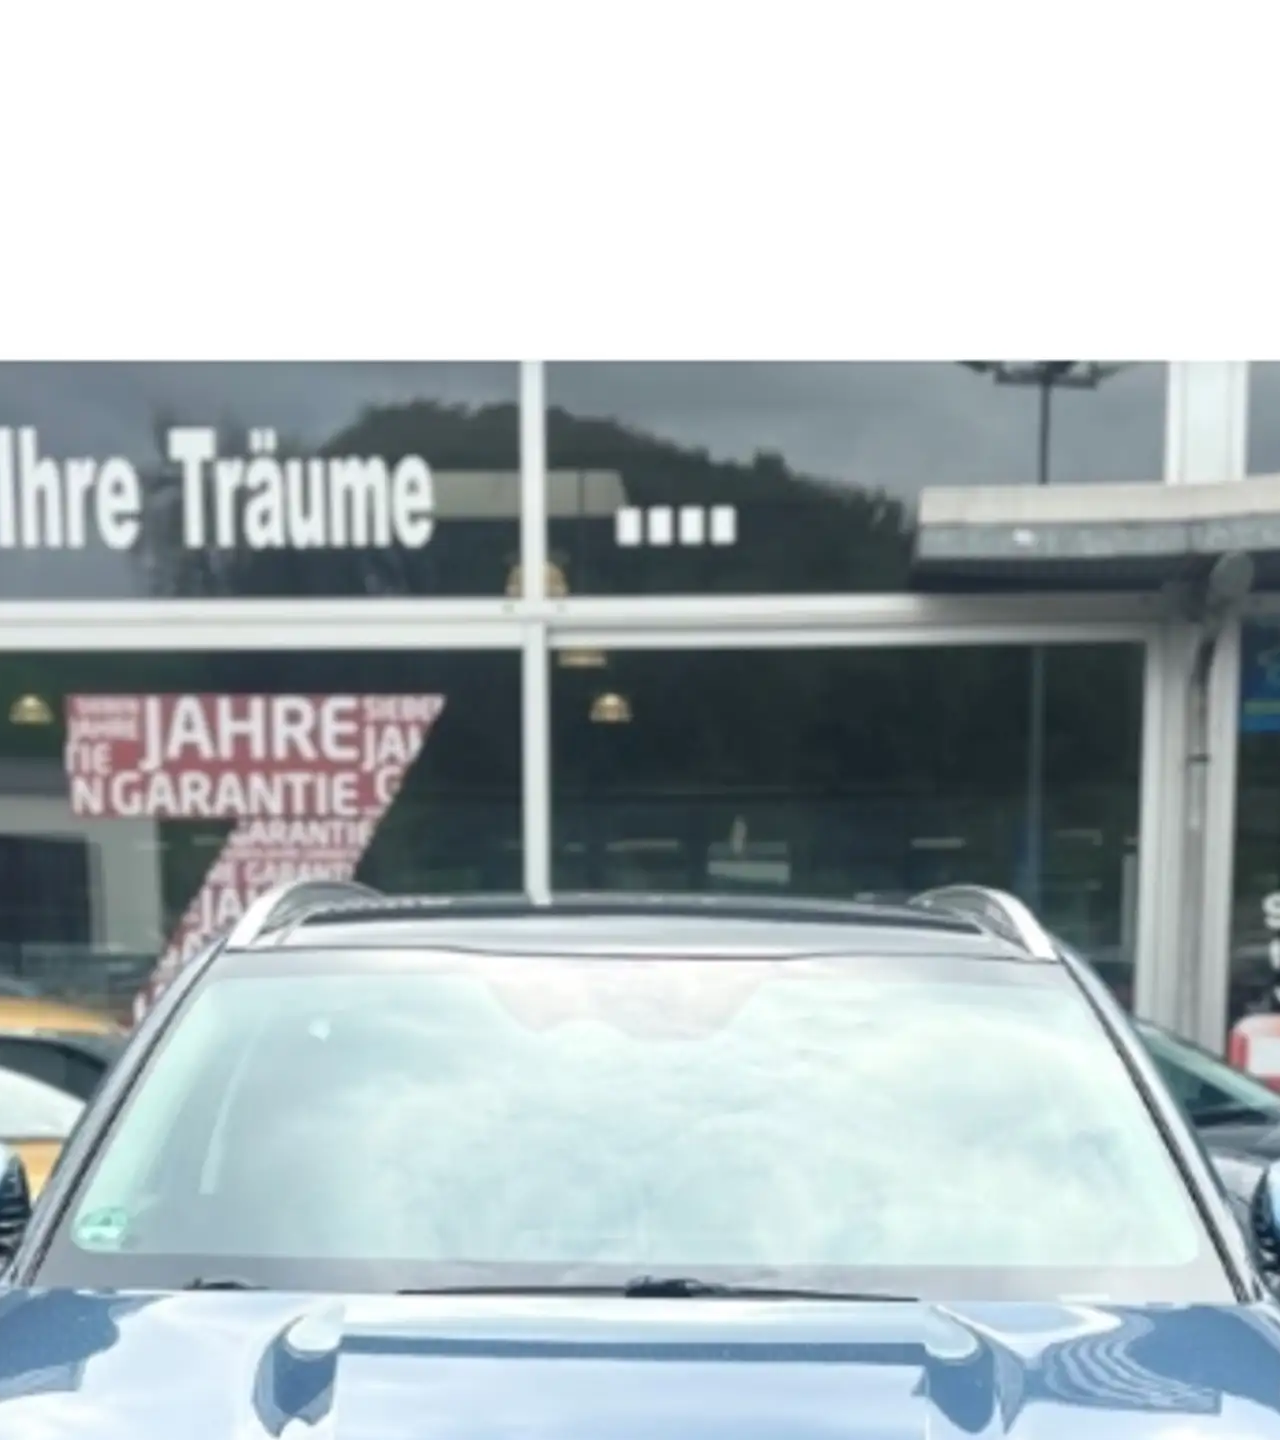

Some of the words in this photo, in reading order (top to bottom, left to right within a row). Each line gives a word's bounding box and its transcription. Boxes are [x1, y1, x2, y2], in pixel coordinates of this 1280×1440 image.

[167, 427, 435, 549] Träume
[138, 694, 358, 772] JAHRE
[111, 771, 359, 815] GARANTIE
